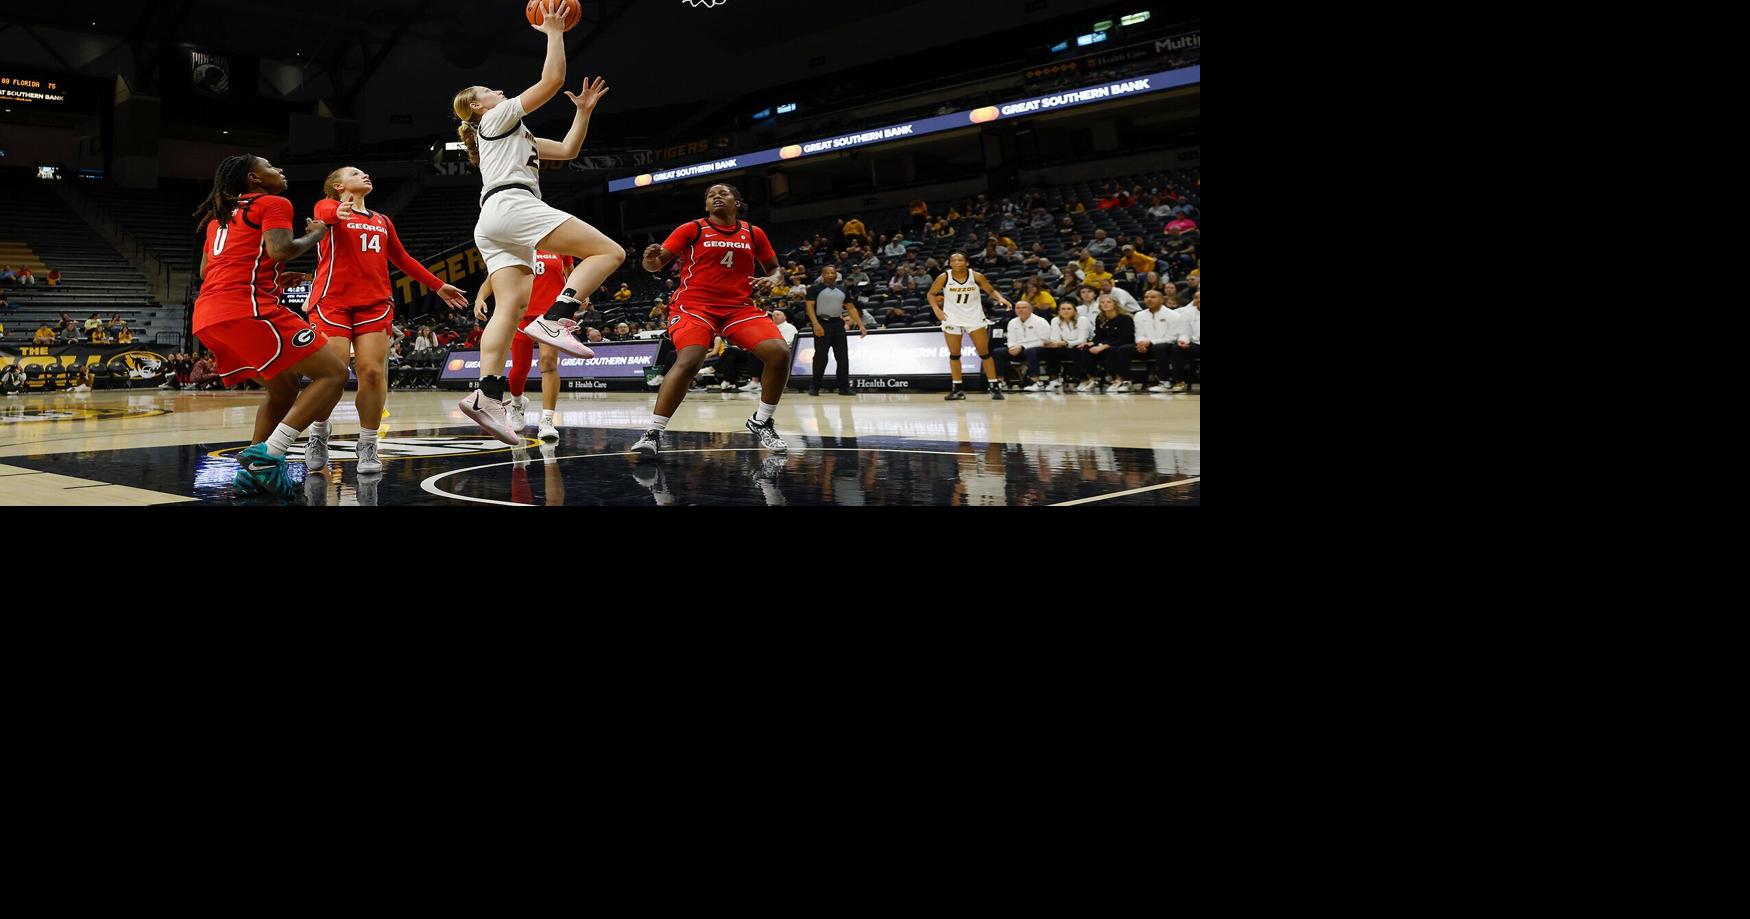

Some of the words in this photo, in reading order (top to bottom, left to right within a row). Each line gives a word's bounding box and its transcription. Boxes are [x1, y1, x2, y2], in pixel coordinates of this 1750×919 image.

[6, 90, 44, 99] SOUTHERN
[1001, 99, 1041, 115] GREAT
[1041, 86, 1110, 108] SOUTHERN
[1111, 78, 1150, 95] BANK
[803, 140, 834, 153] GREAT
[833, 130, 883, 148] SOUTHERN
[884, 124, 913, 138] BANK
[655, 141, 708, 160] TIGERS
[653, 170, 676, 182] GREAT
[676, 163, 715, 178] SOUTHERN
[715, 158, 738, 171] BANK
[213, 224, 228, 256] 0
[360, 233, 381, 253] 14
[703, 240, 751, 250] GEORGIA
[720, 250, 734, 268] 4
[956, 293, 969, 304] 11
[19, 346, 49, 355] THE
[939, 347, 977, 357] BNK
[561, 358, 585, 366] GREAT
[585, 356, 628, 365] SOUTHERN
[627, 355, 652, 364] BANK
[857, 379, 886, 388] Health
[887, 379, 909, 388] Care
